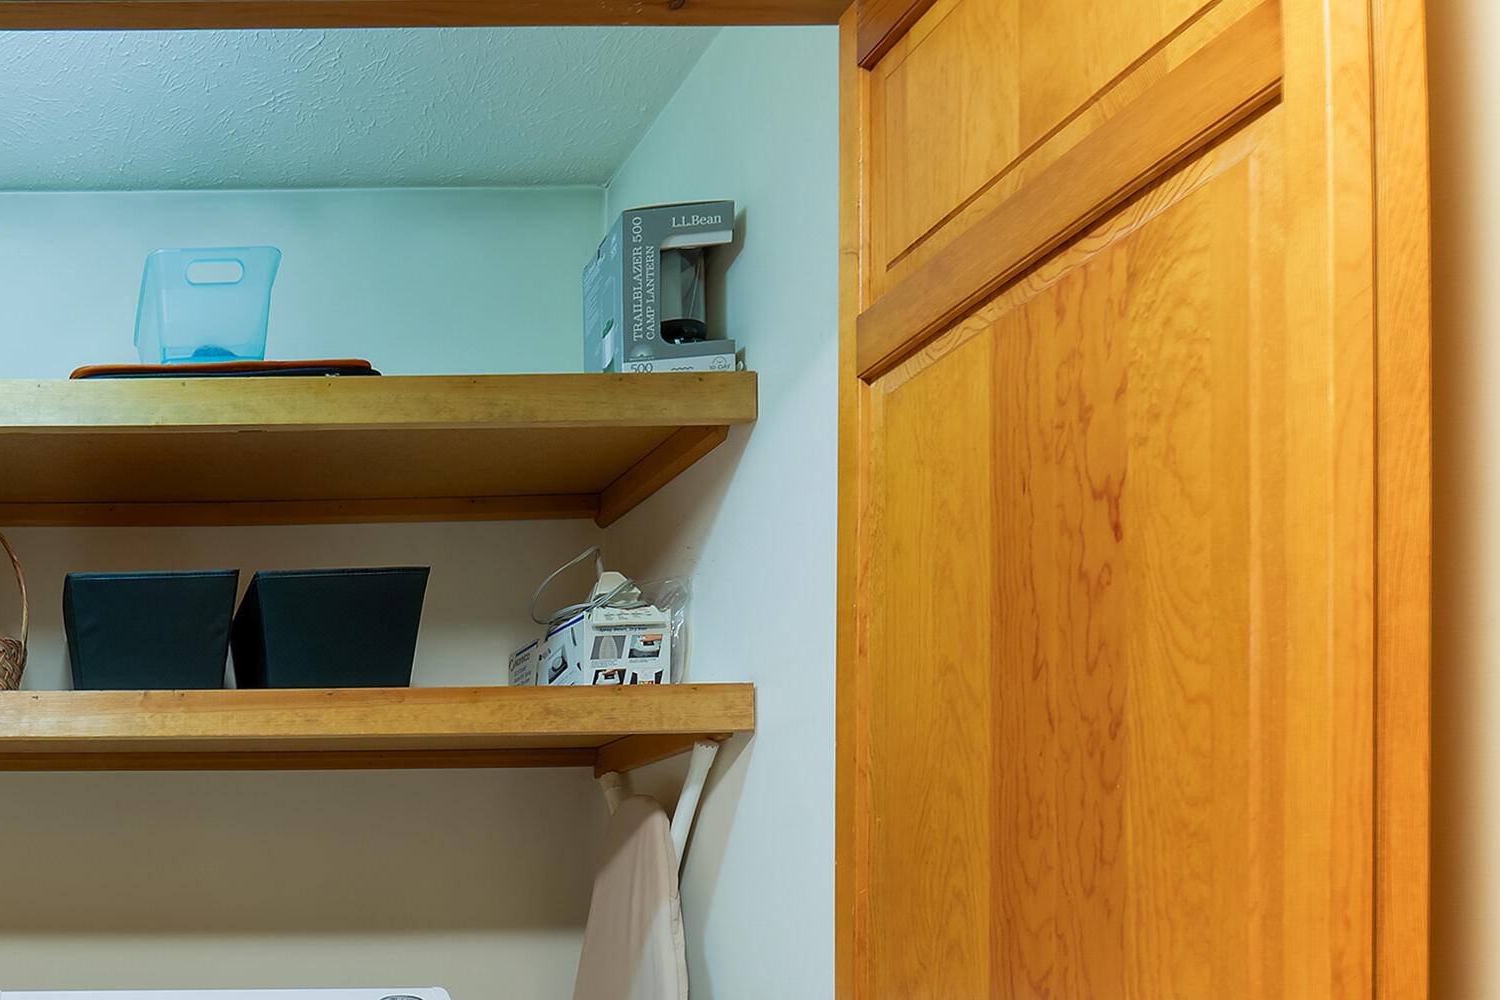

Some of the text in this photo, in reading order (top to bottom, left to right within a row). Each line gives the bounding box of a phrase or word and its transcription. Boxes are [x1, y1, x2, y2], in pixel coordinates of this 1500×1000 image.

[671, 214, 722, 228] L.L.Bean
[631, 216, 643, 342] TRAILBLAZER 500
[645, 245, 655, 340] CAMP LANTERN
